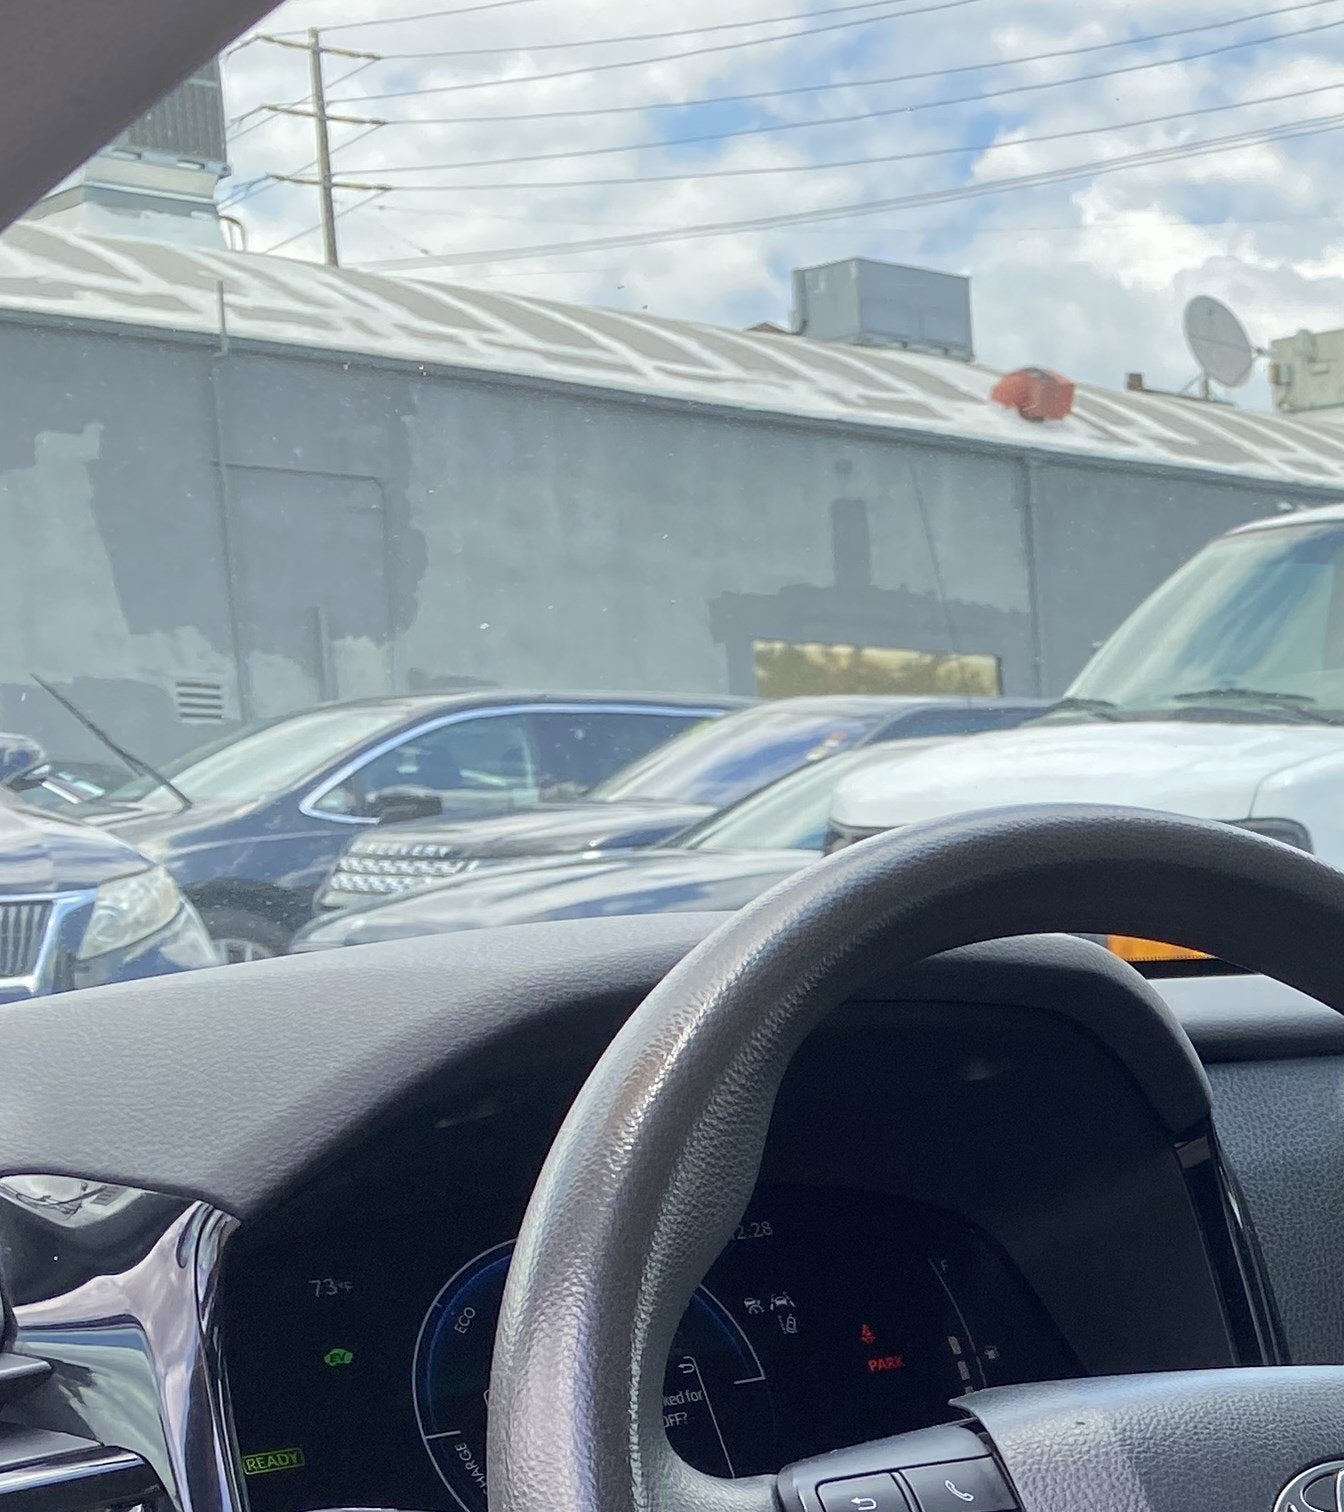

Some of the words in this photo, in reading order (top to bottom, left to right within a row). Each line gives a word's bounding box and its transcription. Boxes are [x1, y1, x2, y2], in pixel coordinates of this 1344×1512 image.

[454, 1306, 477, 1334] ECO
[867, 1355, 903, 1373] PARK
[246, 1451, 301, 1472] READY
[455, 1442, 488, 1497] HARGE
